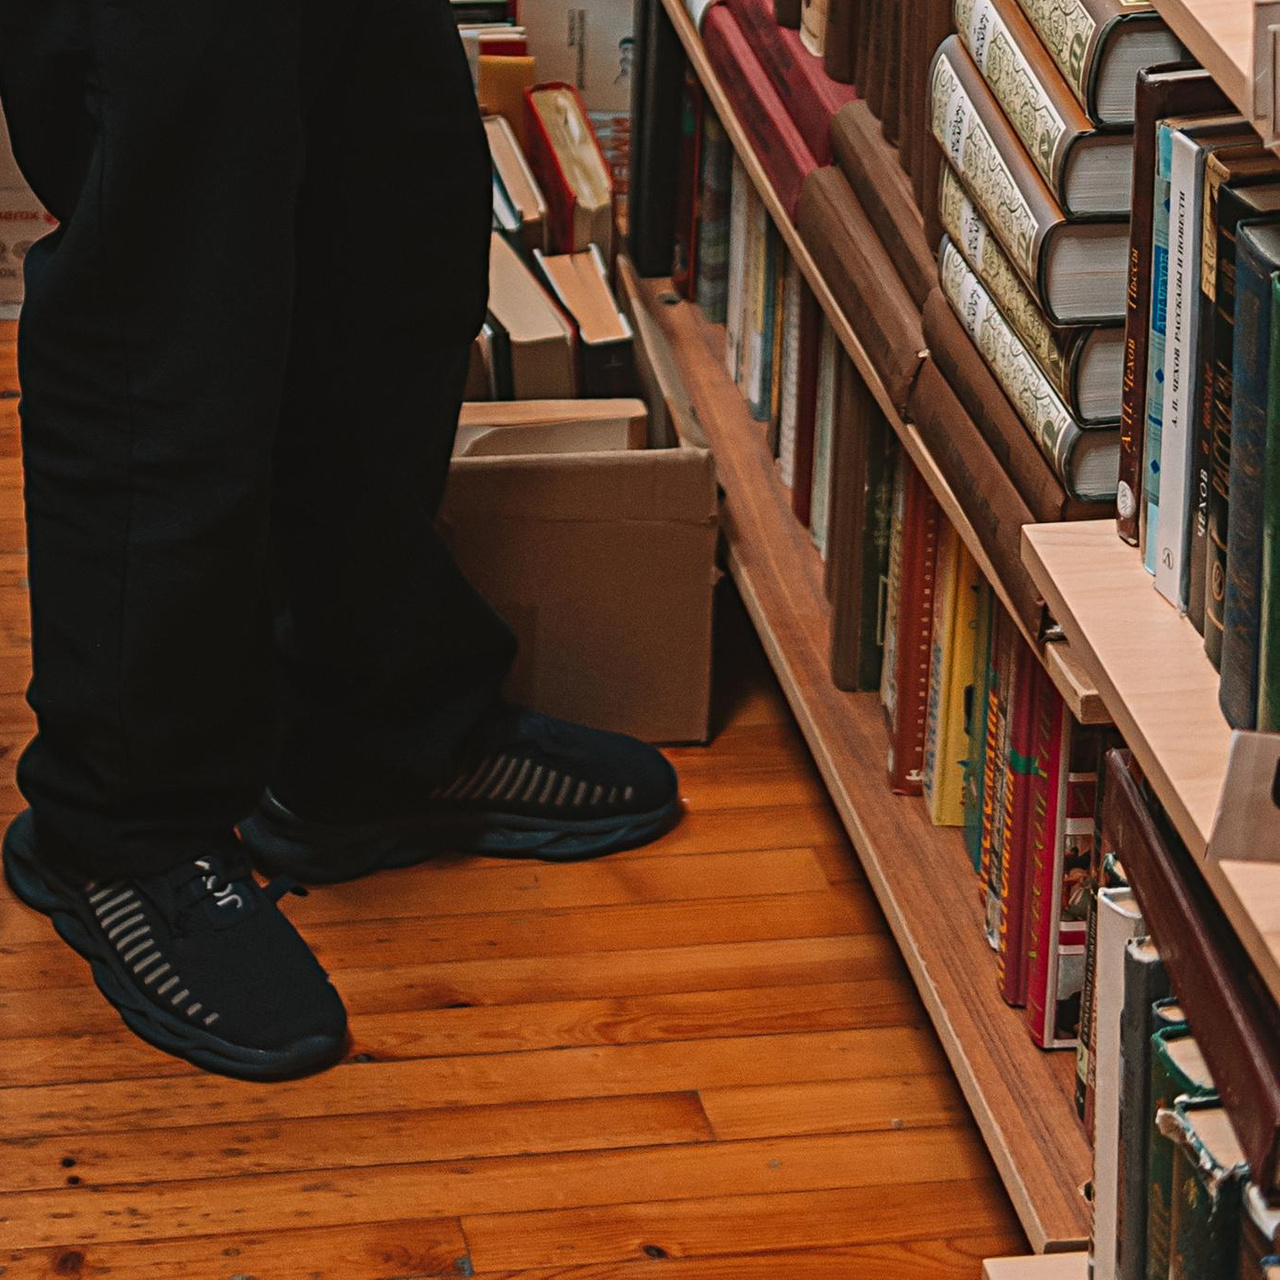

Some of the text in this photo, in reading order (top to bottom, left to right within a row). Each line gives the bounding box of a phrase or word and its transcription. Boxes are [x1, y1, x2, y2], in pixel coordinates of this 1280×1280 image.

[1175, 191, 1186, 256] ПОВЕСТИ
[1126, 245, 1140, 310] Пьесы
[1173, 271, 1184, 343] РАССКАЗЫ
[1122, 337, 1137, 392] Чехов
[1171, 347, 1182, 393] ЧЕХОВ
[1195, 468, 1210, 538] ЧЕХОВ
